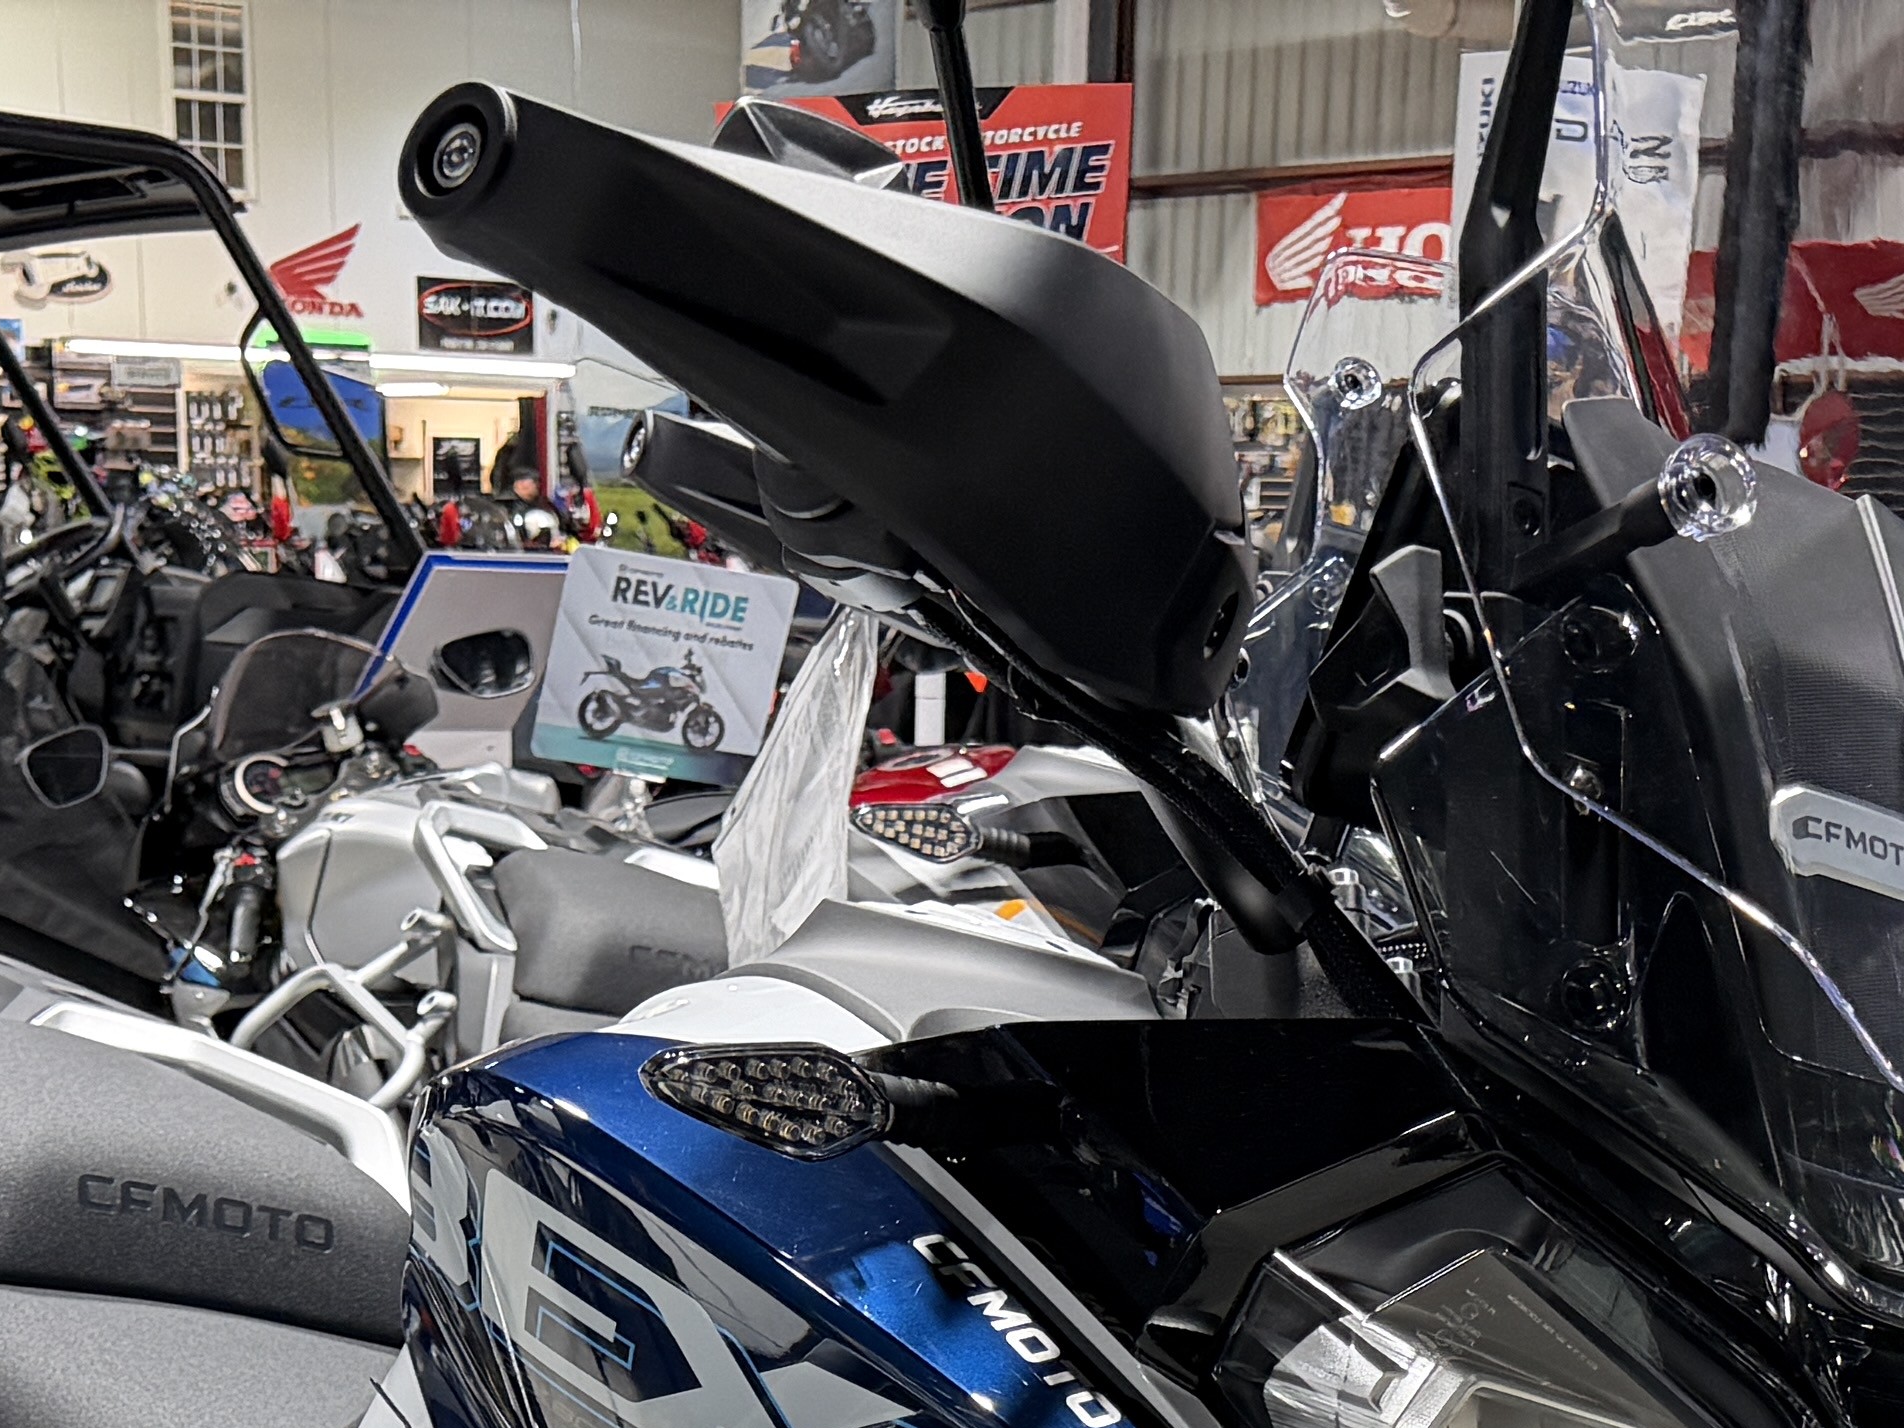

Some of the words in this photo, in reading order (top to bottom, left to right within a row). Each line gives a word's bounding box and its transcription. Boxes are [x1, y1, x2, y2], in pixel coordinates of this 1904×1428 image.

[983, 122, 1083, 146] TORCYCLE
[287, 299, 364, 318] ONDA
[587, 613, 625, 630] Great
[626, 619, 681, 643] financing
[683, 629, 707, 645] and
[708, 634, 755, 652] rebates
[77, 1173, 335, 1254] CFMOTO
